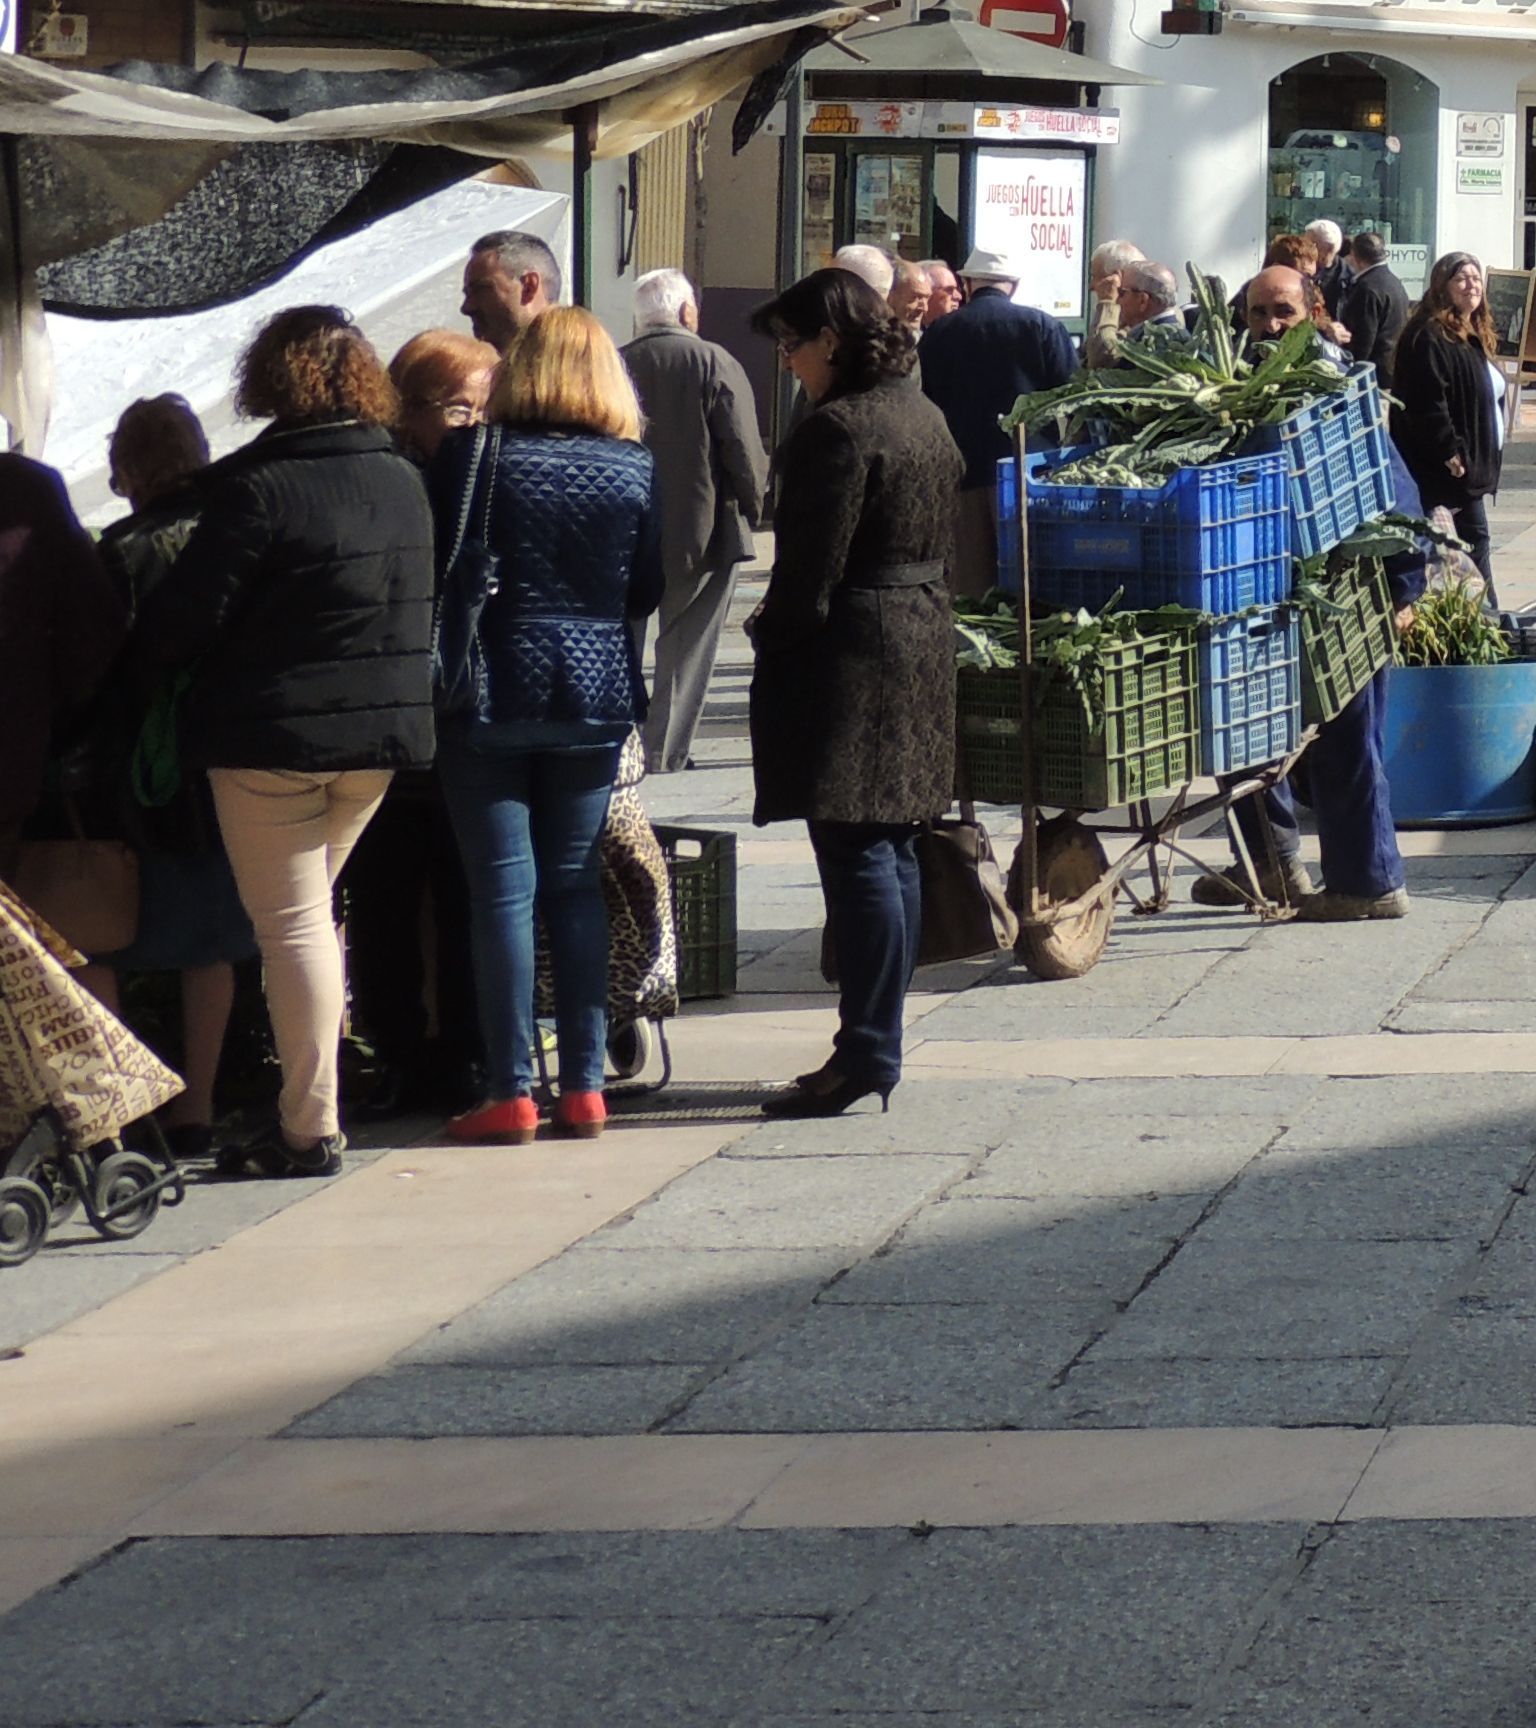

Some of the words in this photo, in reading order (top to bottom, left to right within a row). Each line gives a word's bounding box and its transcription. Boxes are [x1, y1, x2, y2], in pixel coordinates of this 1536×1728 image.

[986, 184, 1020, 203] JUEGOS
[1021, 175, 1074, 216] HUELLA
[1031, 223, 1074, 259] SOCIAL
